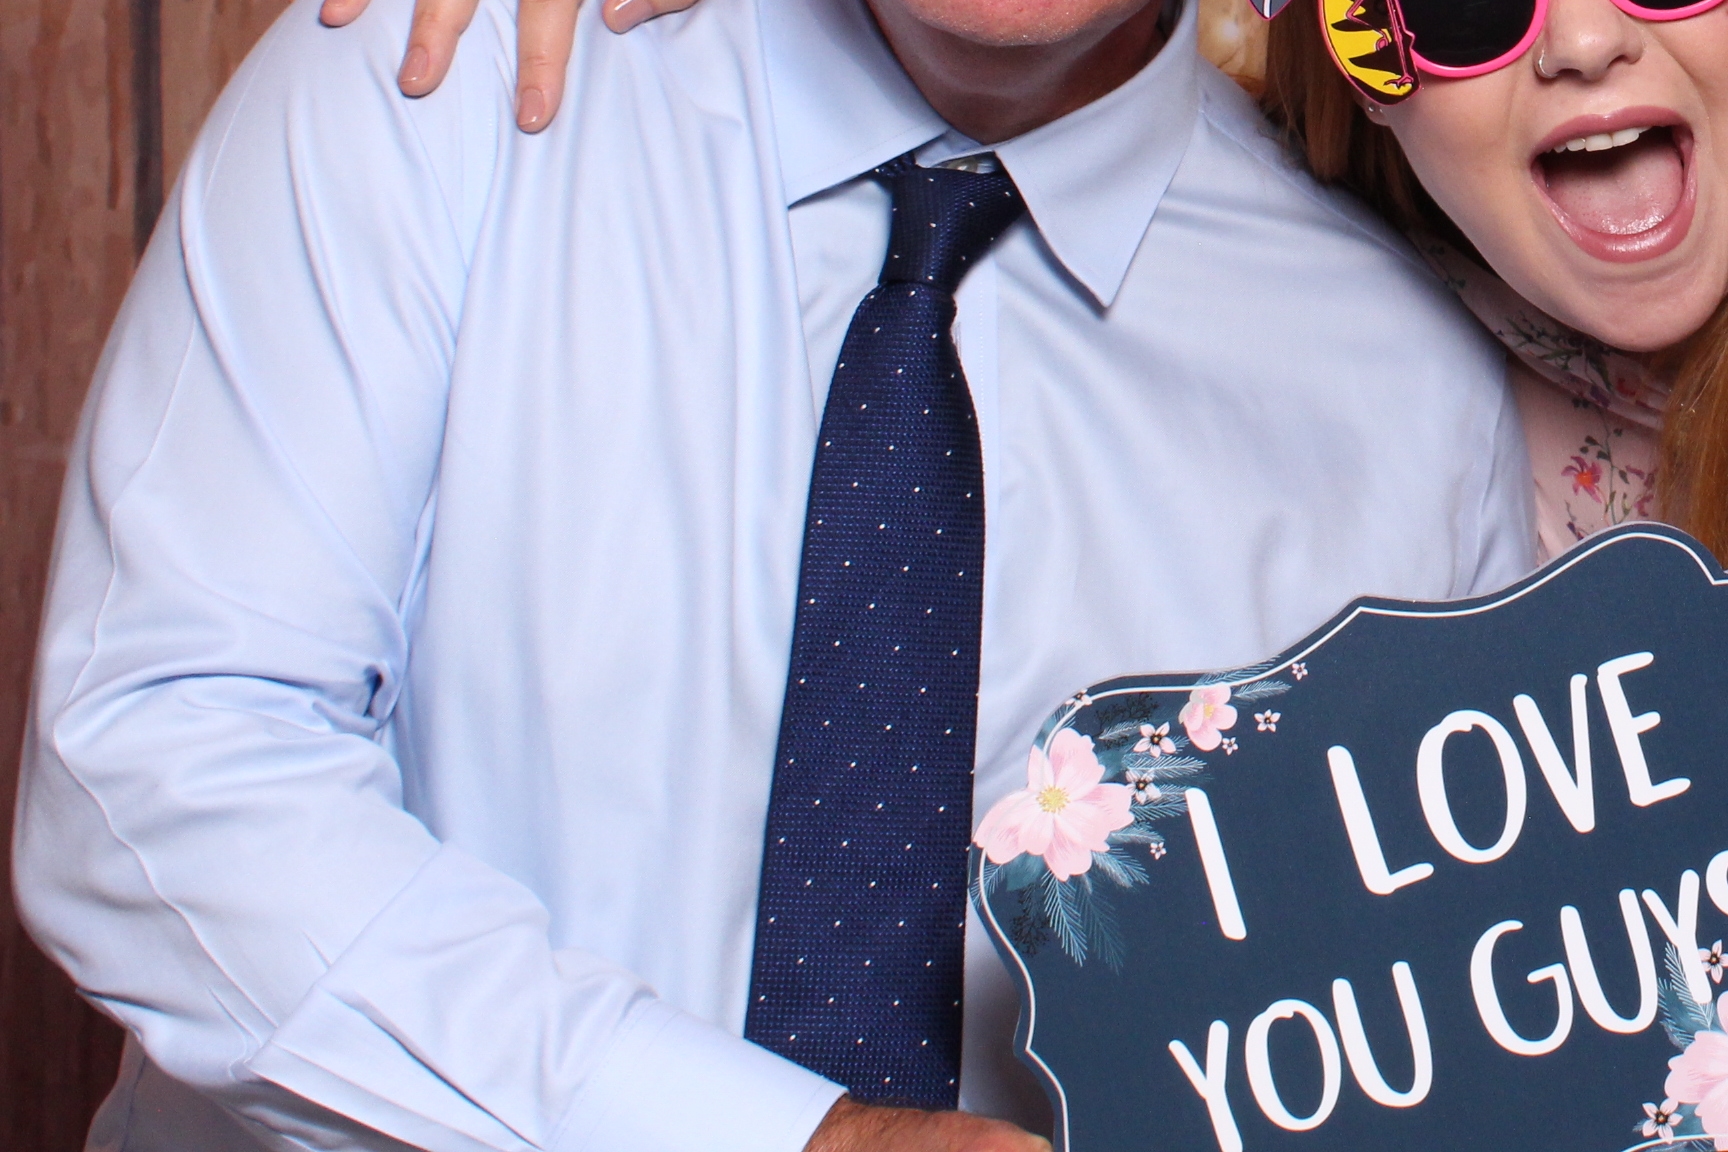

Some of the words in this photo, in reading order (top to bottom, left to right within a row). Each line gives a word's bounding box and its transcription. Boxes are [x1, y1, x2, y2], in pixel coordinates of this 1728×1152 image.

[1184, 785, 1247, 942] I
[1326, 650, 1691, 896] LOVE
[1168, 959, 1435, 1152] YOU
